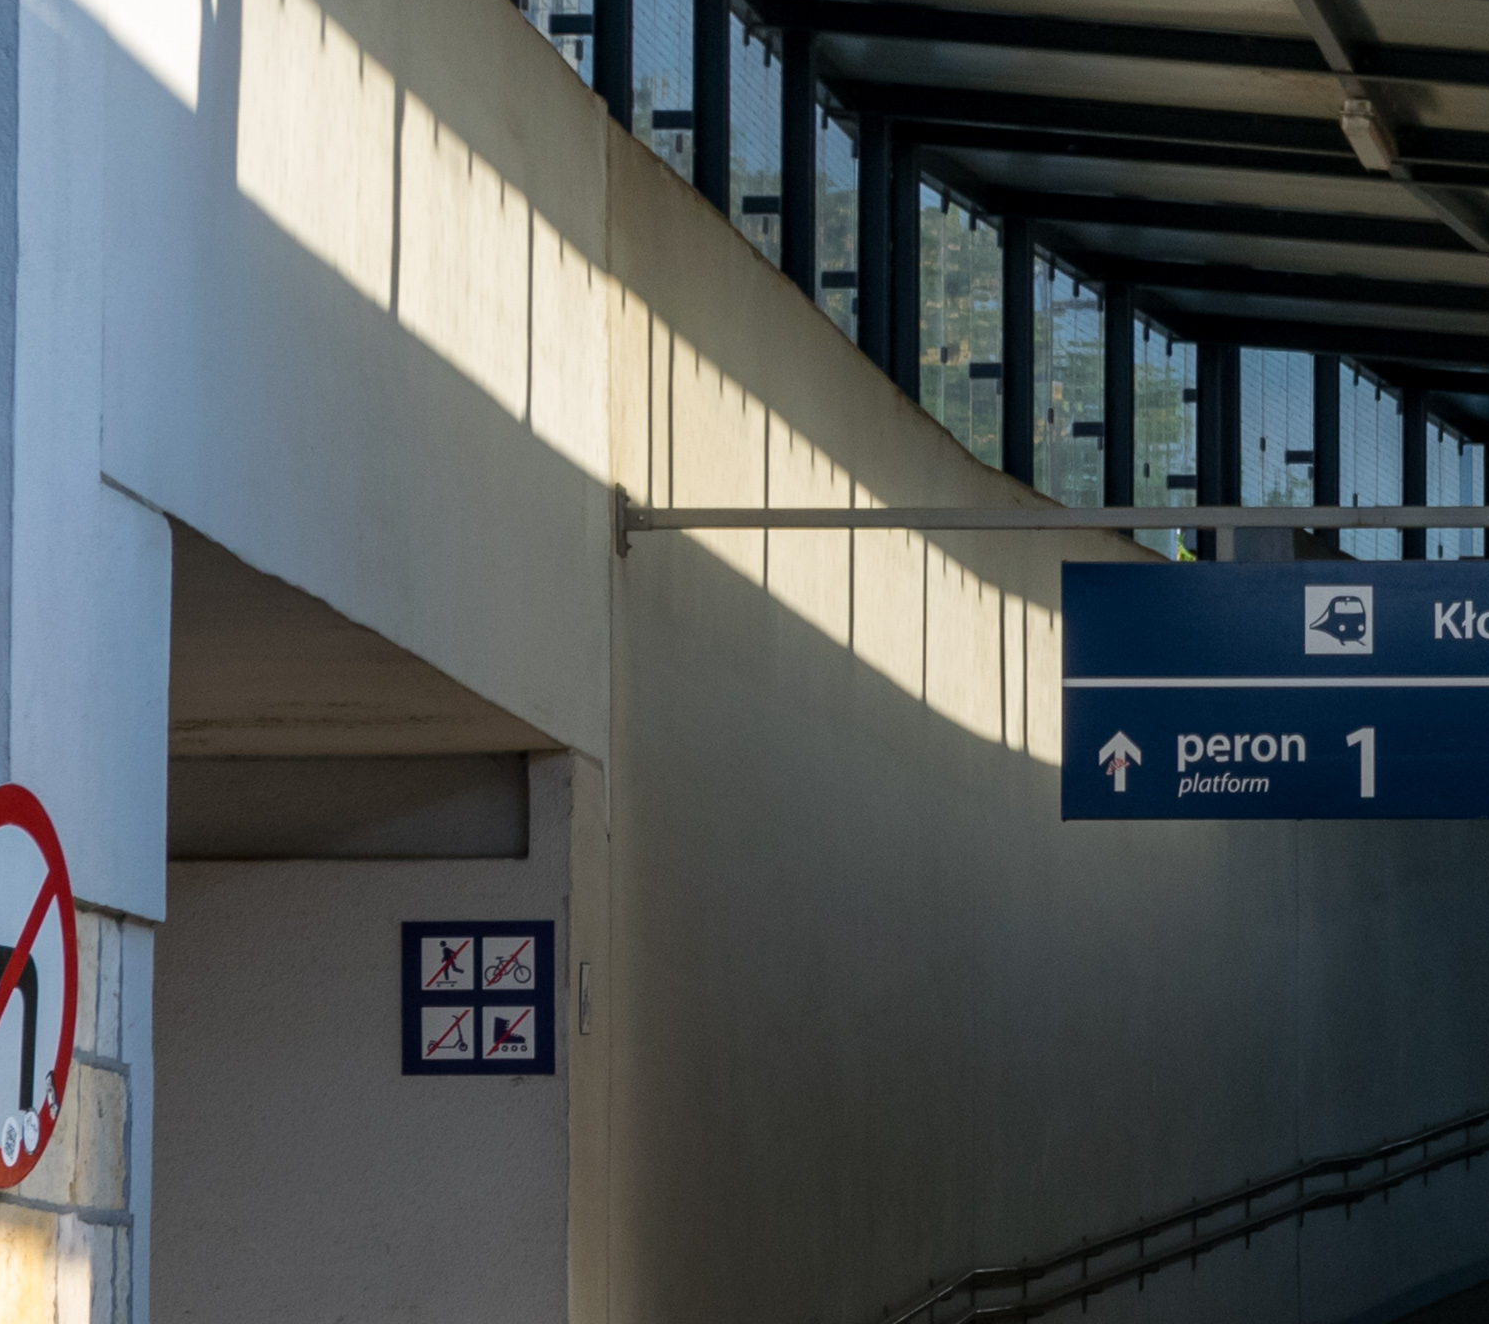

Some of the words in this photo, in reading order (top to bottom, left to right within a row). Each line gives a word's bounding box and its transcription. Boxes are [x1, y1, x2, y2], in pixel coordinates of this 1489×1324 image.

[1176, 733, 1306, 773] peron
[1345, 727, 1376, 798] 1
[1177, 772, 1270, 798] platform
